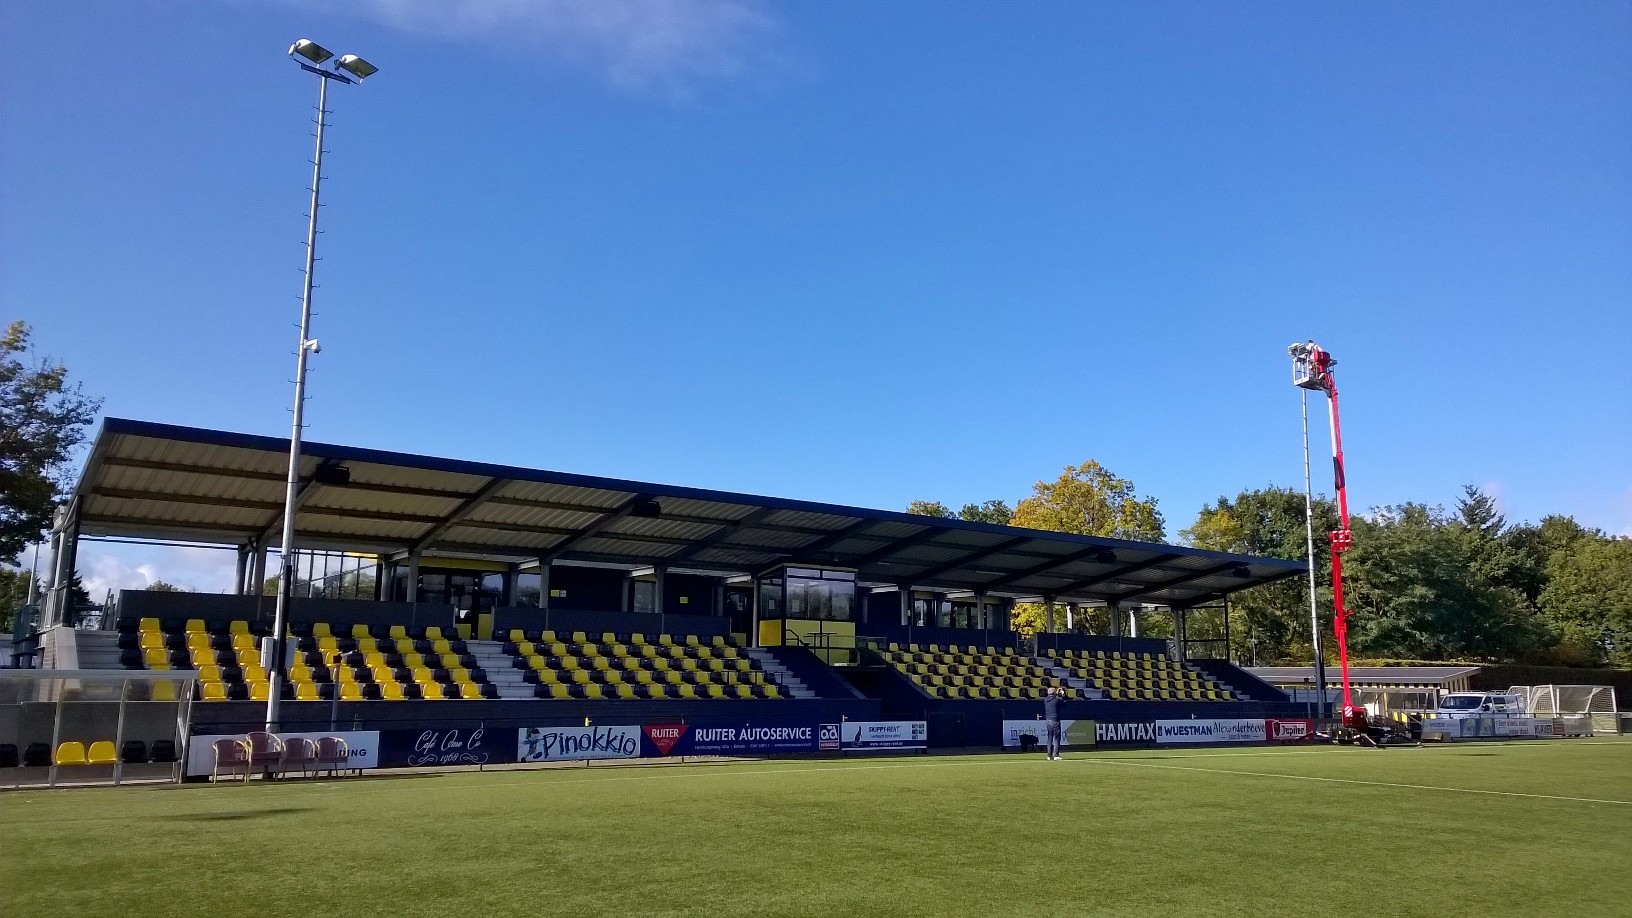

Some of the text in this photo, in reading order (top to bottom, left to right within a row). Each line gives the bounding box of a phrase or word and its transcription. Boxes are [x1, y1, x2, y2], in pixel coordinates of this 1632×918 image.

[651, 728, 680, 739] RUITER
[1095, 722, 1156, 741] HAMTAX
[1164, 725, 1213, 736] WUESTMAN
[1212, 720, 1265, 734] Alexanderhoeve
[1281, 725, 1305, 736] Jupiler
[695, 727, 812, 742] RUITER AUTOSERVICE
[543, 727, 637, 759] Pinokkio
[440, 752, 459, 765] 1968
